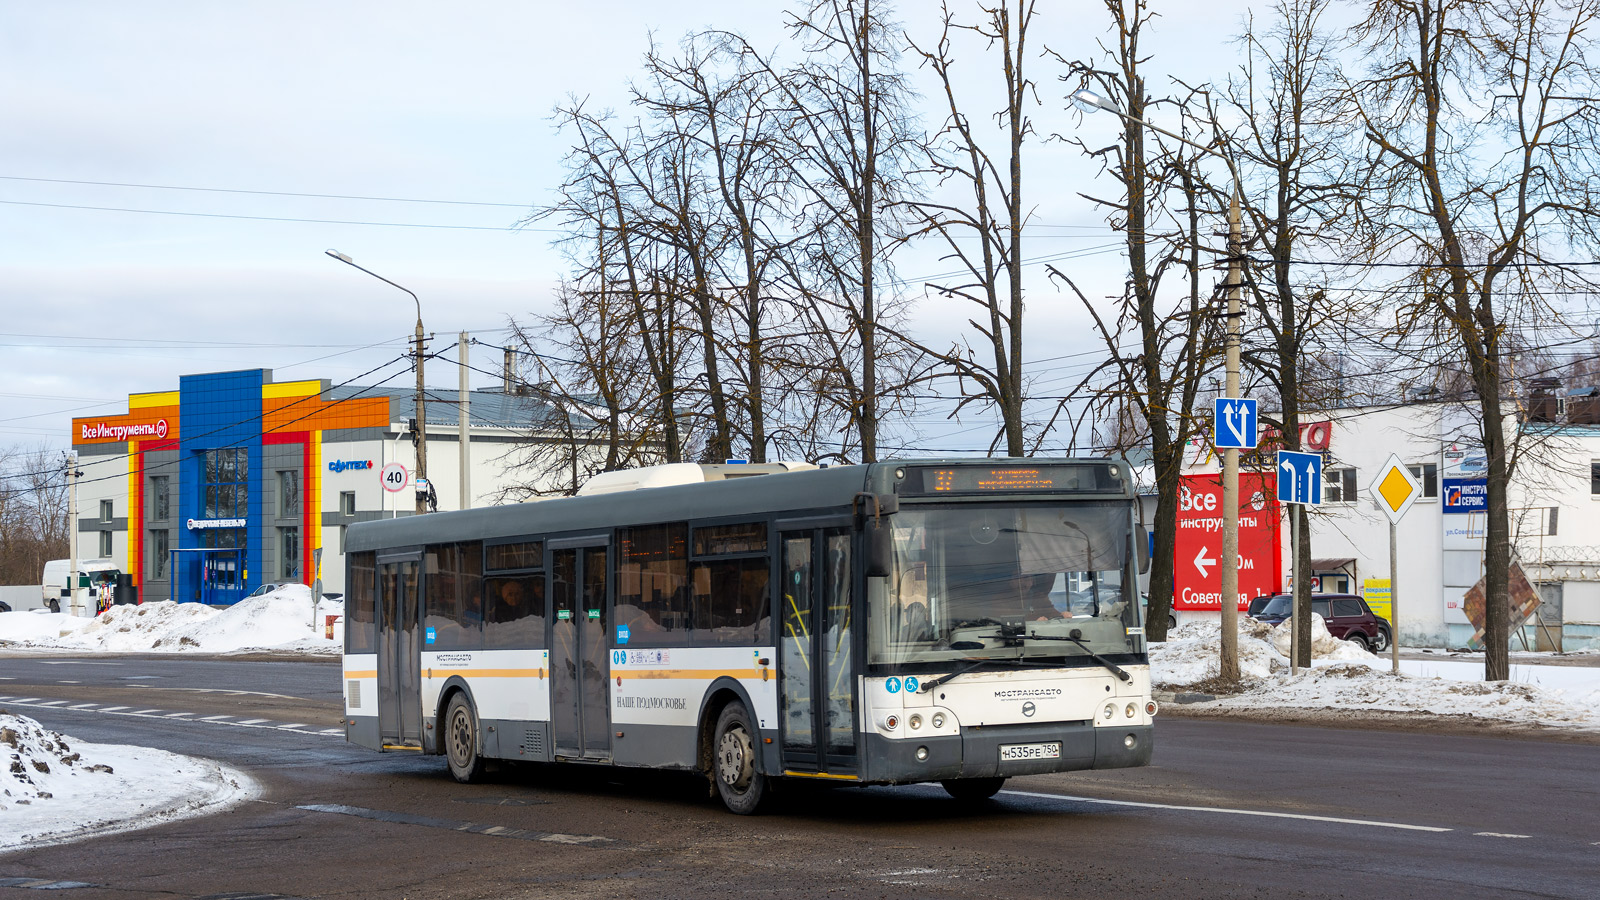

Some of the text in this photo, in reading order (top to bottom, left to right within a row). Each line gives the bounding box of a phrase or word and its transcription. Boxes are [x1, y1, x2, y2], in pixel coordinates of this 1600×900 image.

[386, 471, 402, 484] 40
[1180, 485, 1217, 511] Все
[1461, 496, 1484, 506] СЕРВИС
[1180, 517, 1258, 533] инструнты
[994, 688, 1062, 698] МОСТРАНСАВТО
[616, 696, 687, 710] НАШЕ ПОДМОСКОВЬЕ
[1004, 744, 1057, 759] Н535РЕ 750
